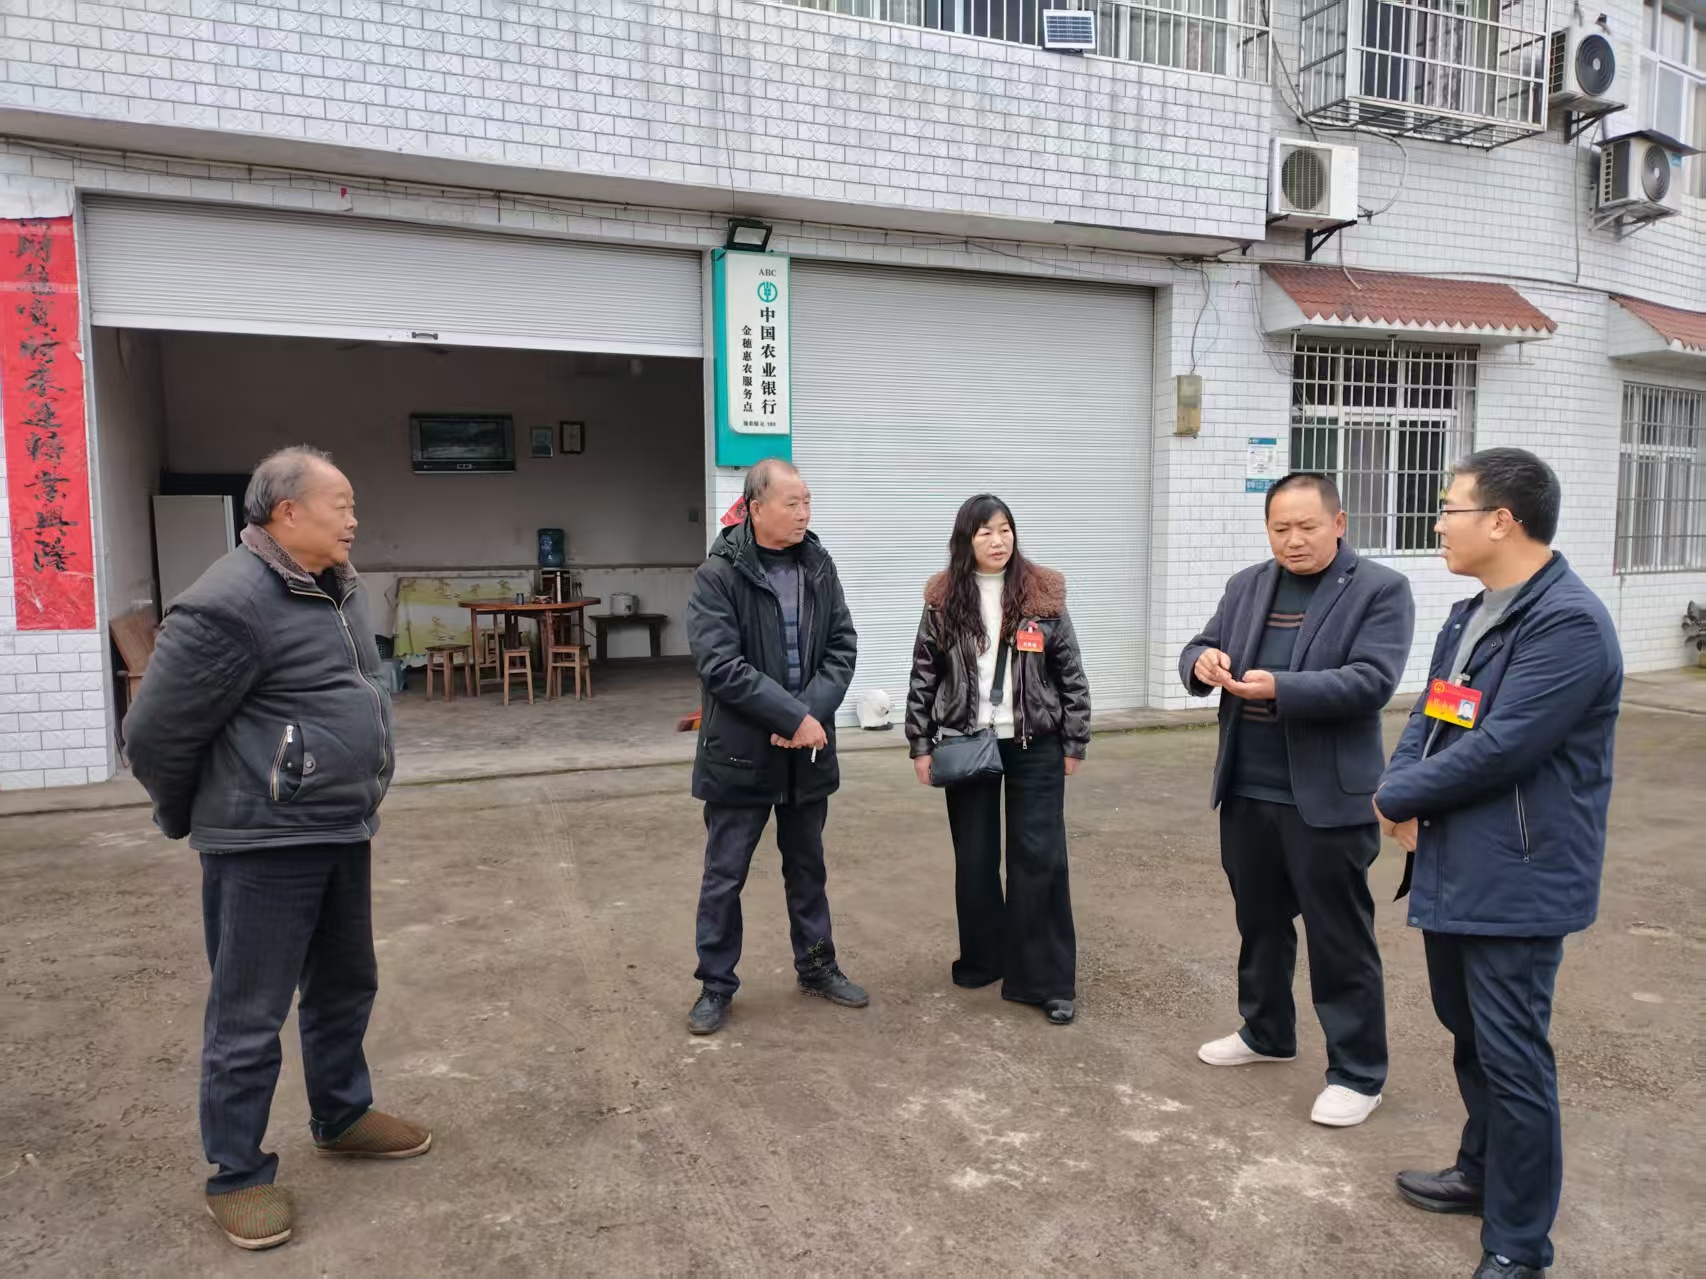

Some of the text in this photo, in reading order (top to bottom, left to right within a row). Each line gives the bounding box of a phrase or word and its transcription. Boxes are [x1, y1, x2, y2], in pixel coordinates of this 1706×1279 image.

[758, 268, 777, 277] ABC
[742, 325, 753, 413] 金穗惠农服务点
[760, 306, 777, 415] 中国农业银行
